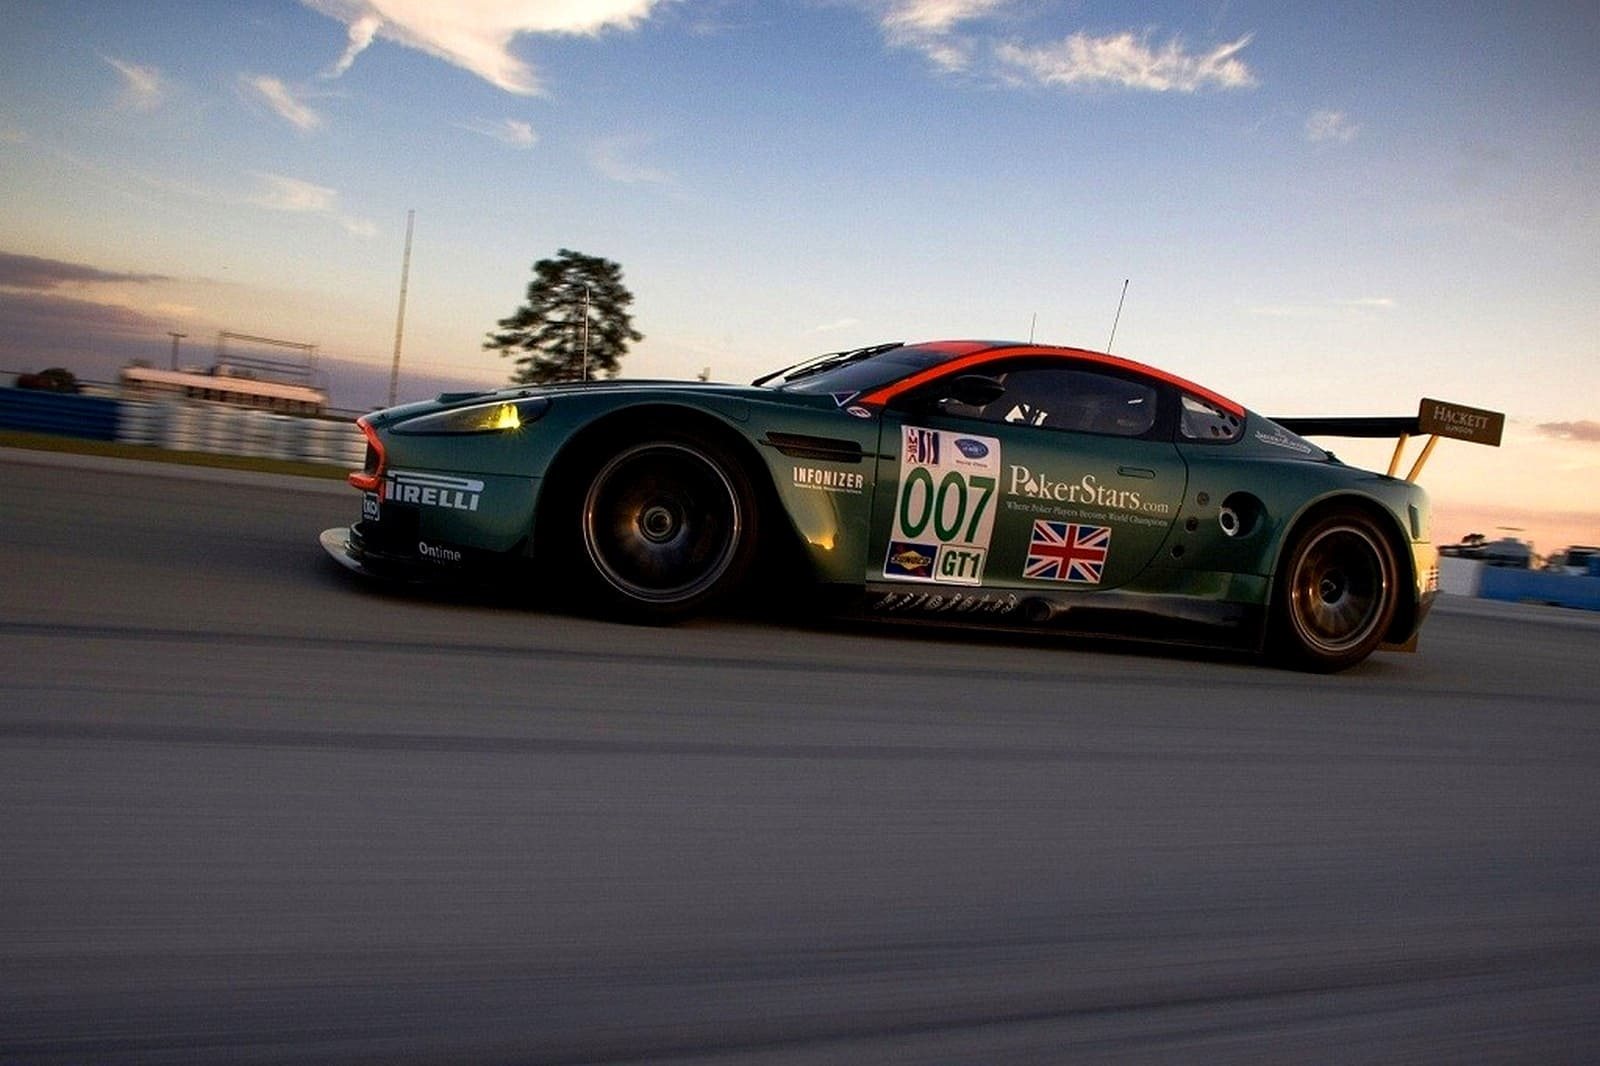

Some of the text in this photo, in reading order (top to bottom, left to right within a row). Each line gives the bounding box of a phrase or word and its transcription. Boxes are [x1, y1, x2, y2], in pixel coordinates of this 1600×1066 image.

[1433, 405, 1489, 430] HACKETT
[793, 466, 864, 489] INFONIZER
[900, 467, 996, 543] 007
[419, 541, 461, 561] Ontime
[941, 550, 981, 578] GT1
